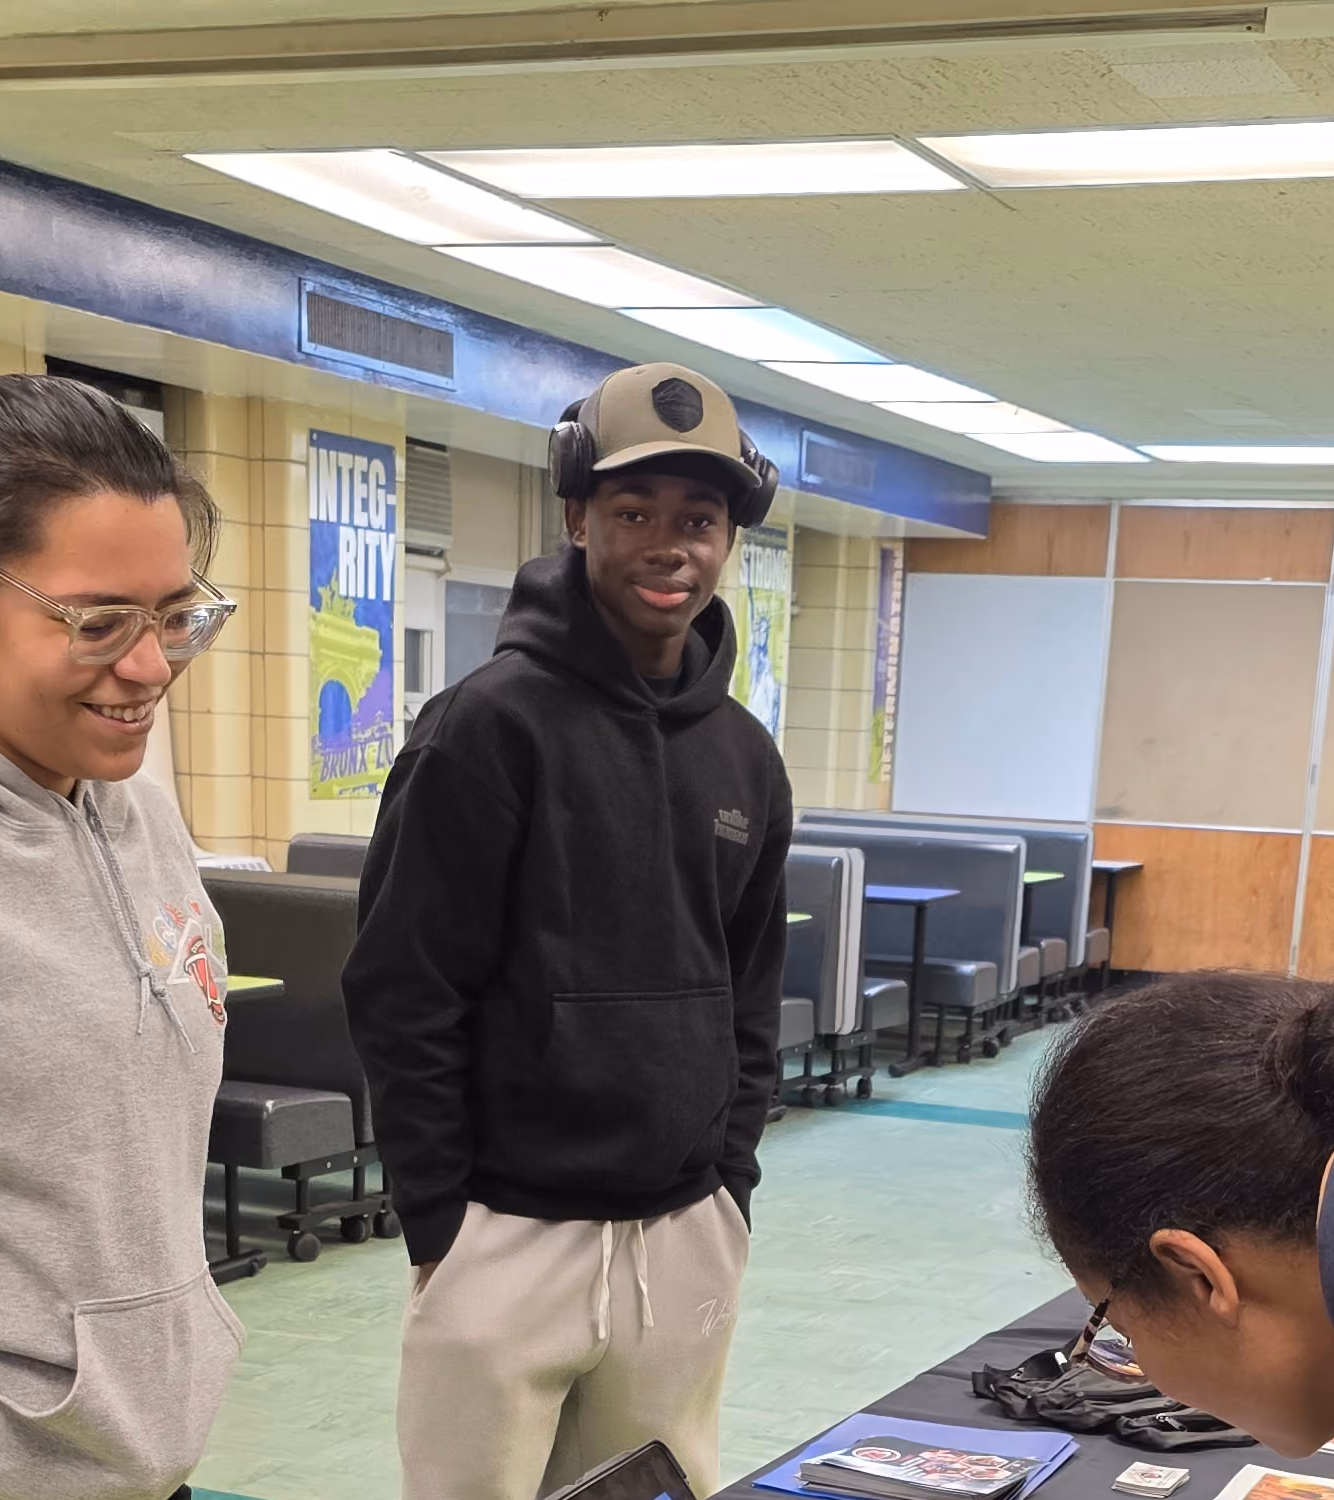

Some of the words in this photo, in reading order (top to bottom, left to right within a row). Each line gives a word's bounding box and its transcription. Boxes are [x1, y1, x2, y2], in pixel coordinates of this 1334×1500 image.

[309, 446, 396, 530] INTEG-
[339, 525, 396, 601] RITY
[320, 741, 367, 782] BRONX
